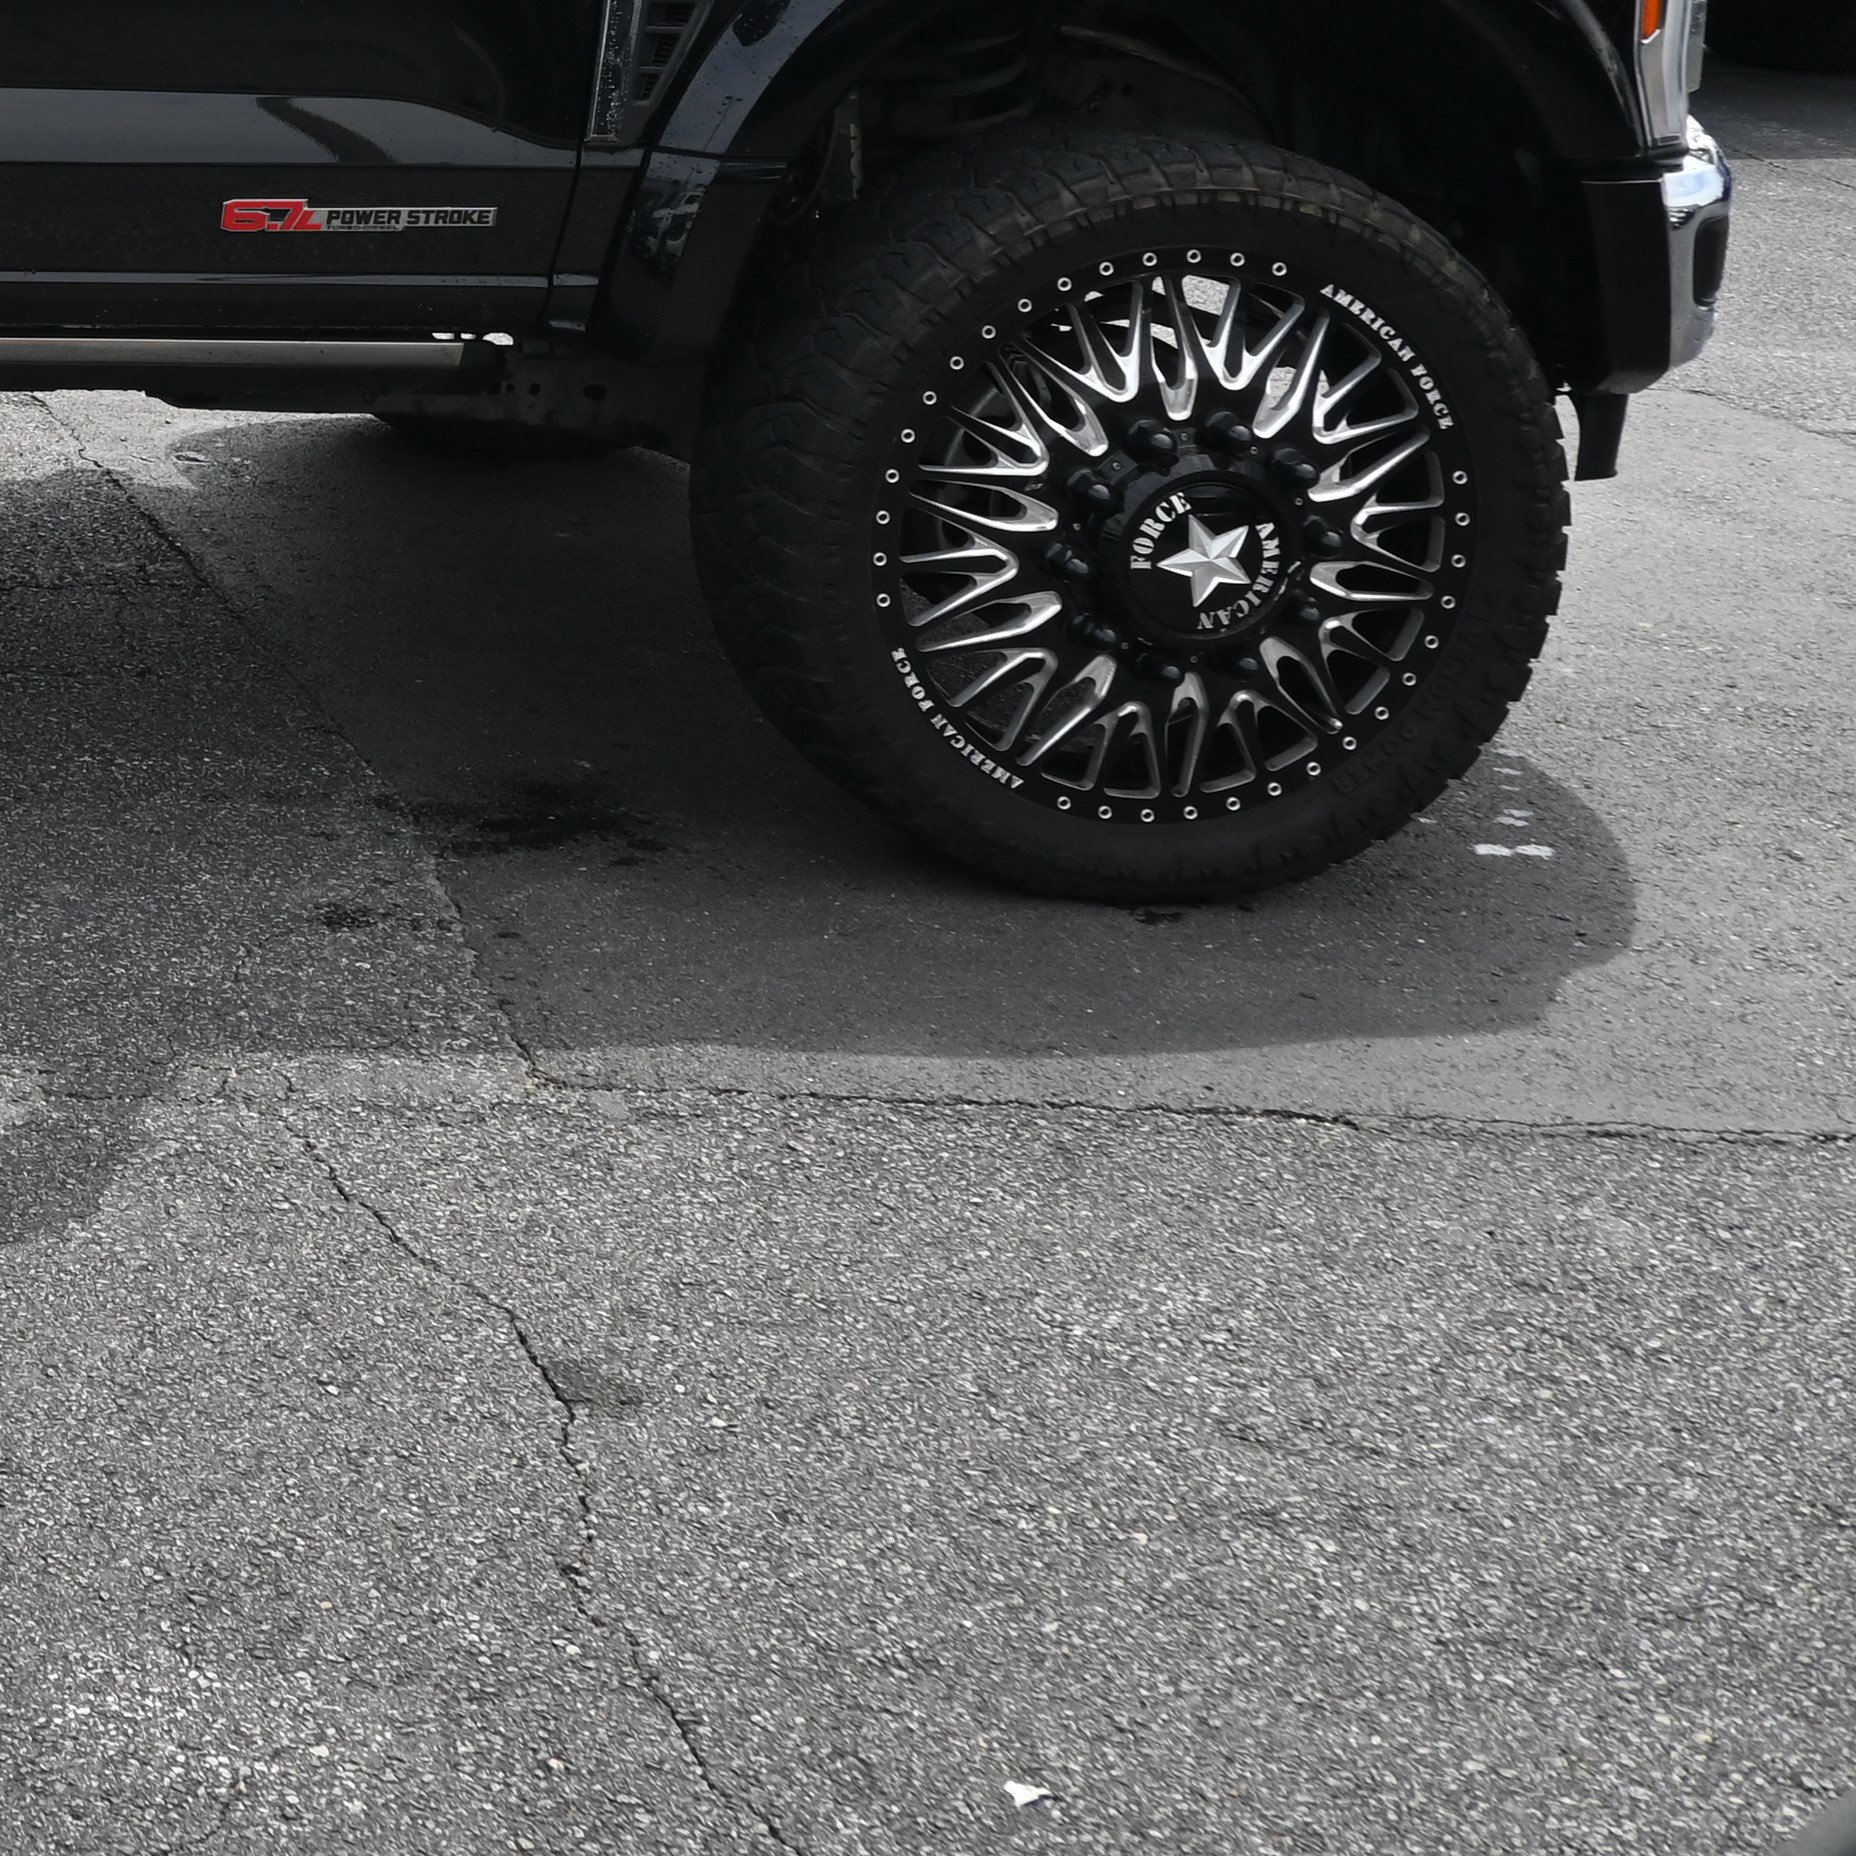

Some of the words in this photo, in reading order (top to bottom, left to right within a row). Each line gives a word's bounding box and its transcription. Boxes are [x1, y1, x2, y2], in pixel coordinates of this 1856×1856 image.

[326, 209, 402, 225] POWER
[406, 209, 491, 225] STROKE
[1320, 283, 1416, 362] AMERICAN
[1410, 363, 1454, 430] FORCE
[1130, 492, 1192, 570] FORCE
[1196, 522, 1281, 630] AMERICAN
[891, 647, 935, 712] FORCE
[930, 713, 1025, 789] AMERICAN
